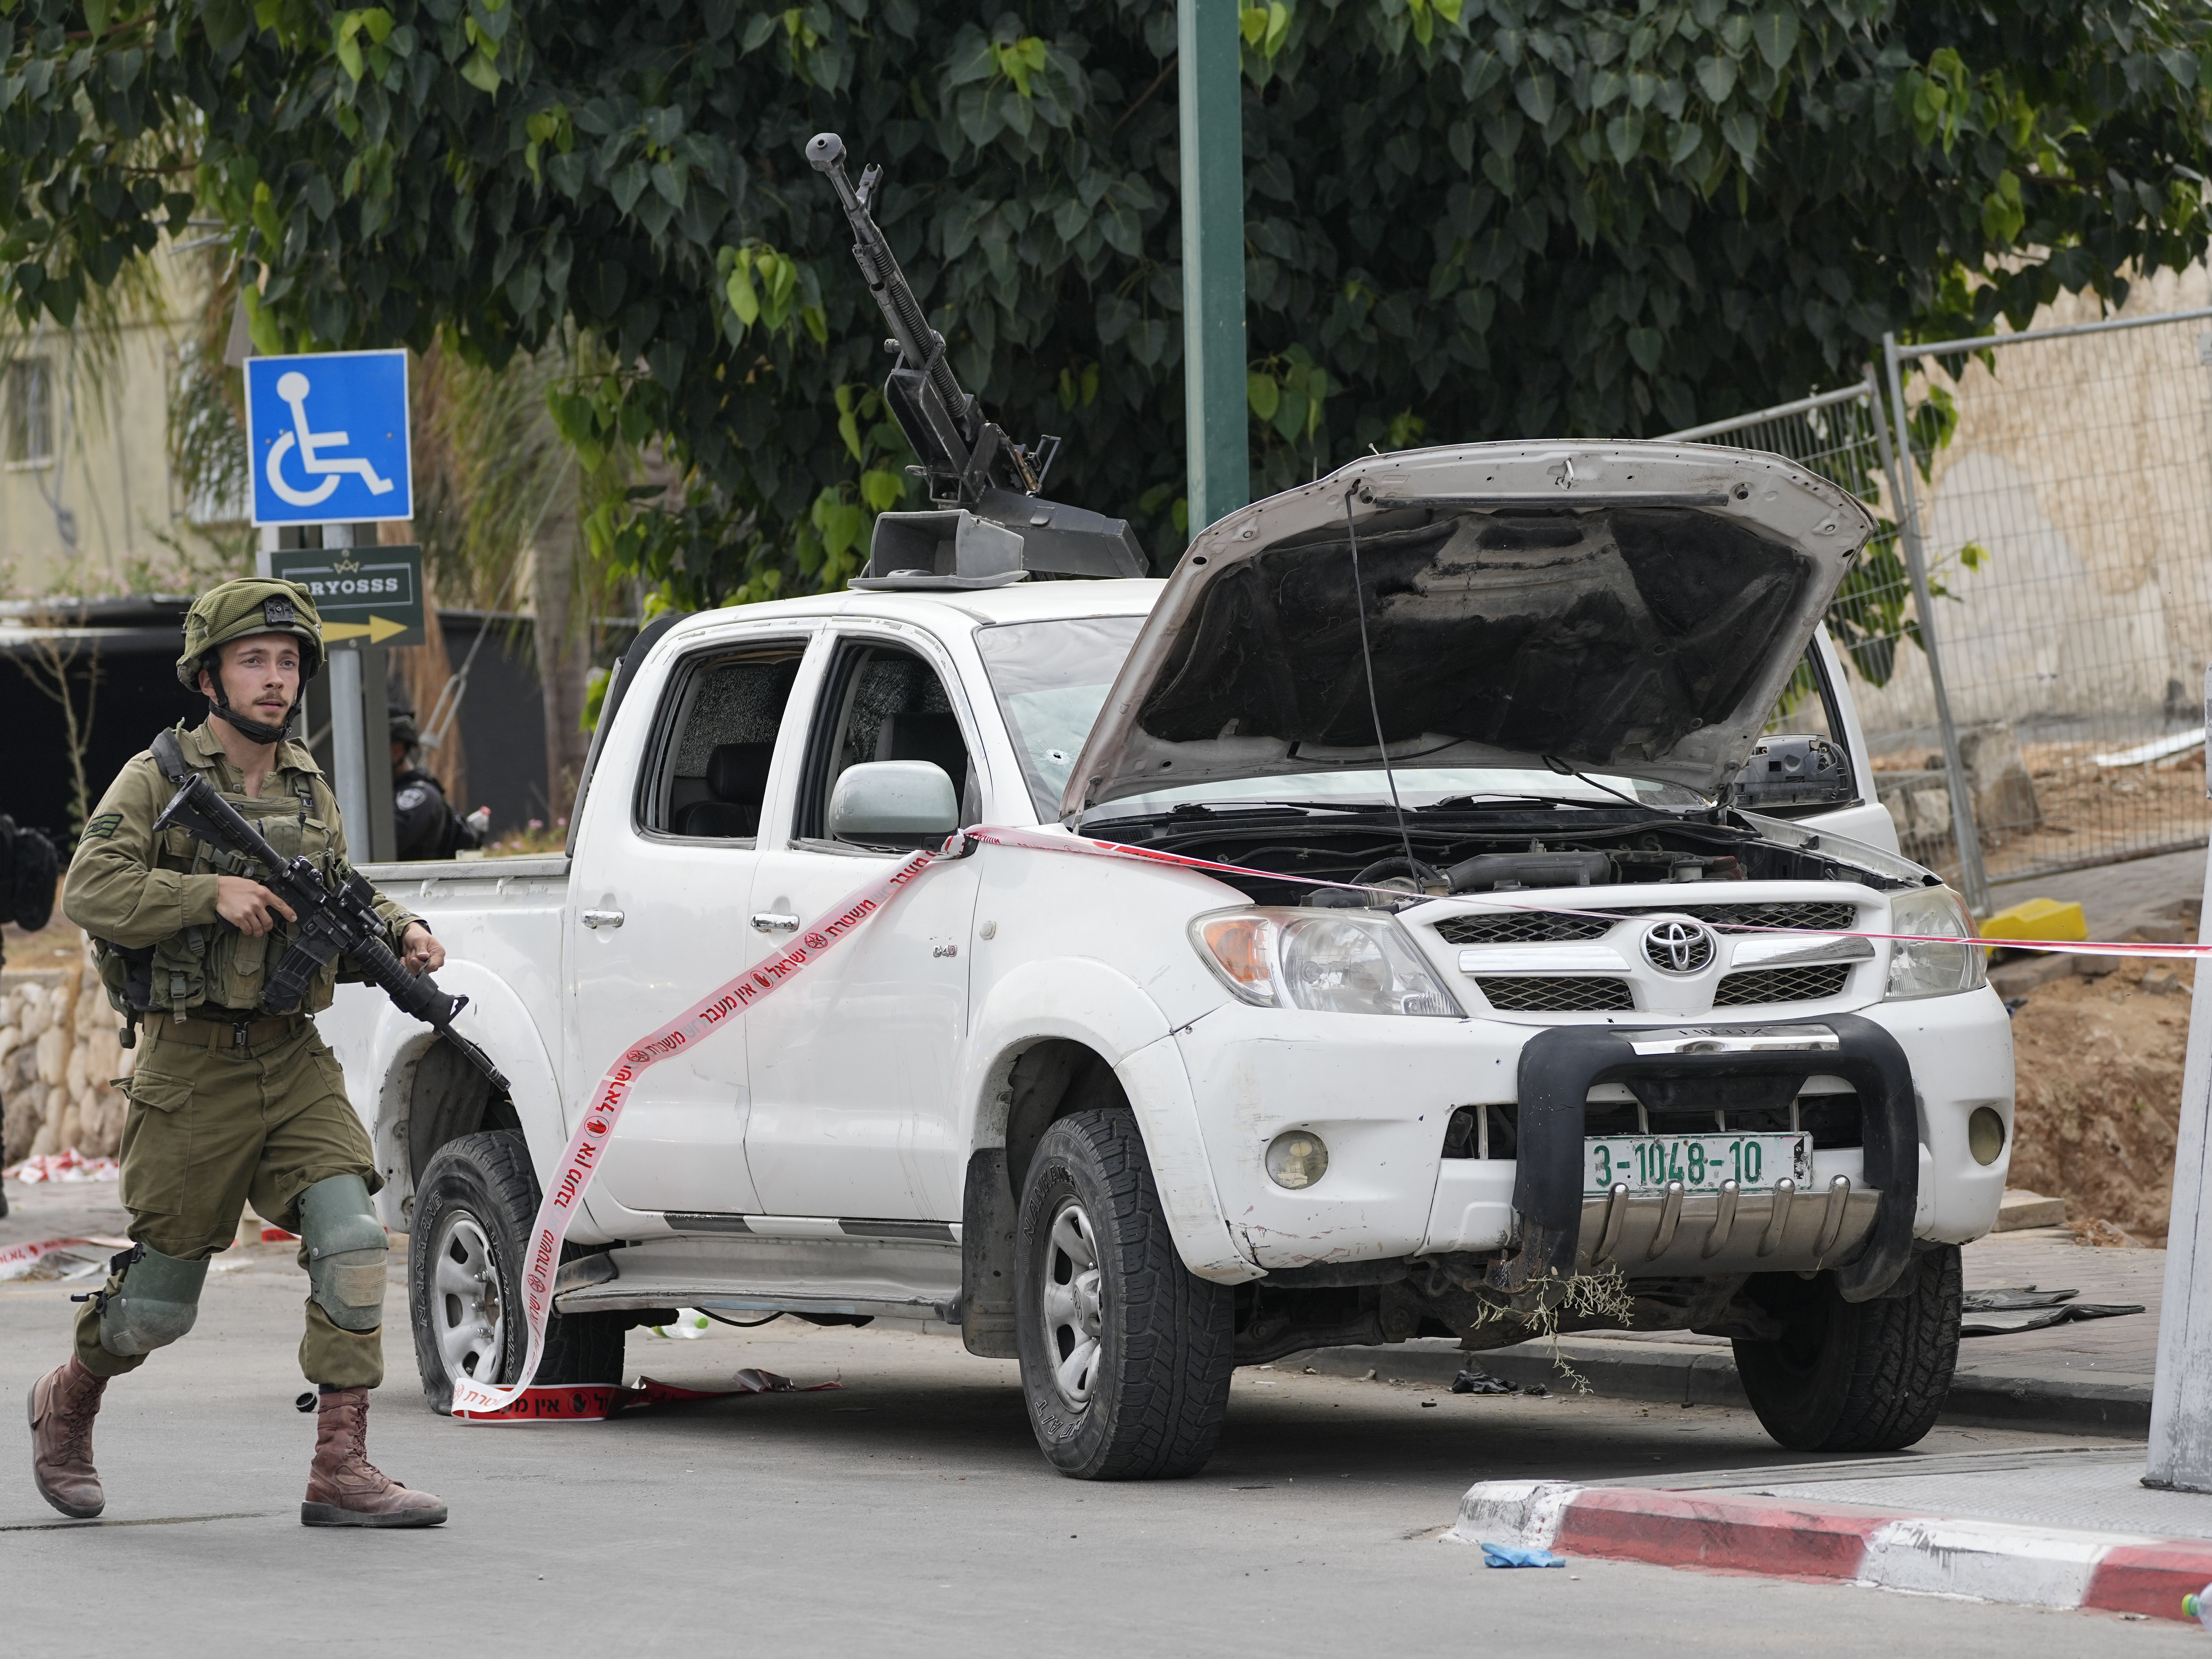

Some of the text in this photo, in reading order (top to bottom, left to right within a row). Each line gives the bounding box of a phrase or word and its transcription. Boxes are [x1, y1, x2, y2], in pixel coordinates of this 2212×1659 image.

[299, 578, 398, 596] RYOSSS
[824, 899, 877, 937] משטרת
[766, 947, 807, 979] ישראל
[699, 996, 738, 1024] מעבר
[734, 983, 758, 1006] אין
[644, 1031, 686, 1055] משטרת
[595, 1065, 632, 1113] ישראל
[574, 1142, 597, 1169] אין
[1594, 1140, 1762, 1187] 3-1048-10
[554, 1169, 582, 1208] מעבר
[416, 1190, 443, 1327] NANKANG
[534, 1229, 554, 1278] משטרת
[534, 1398, 560, 1416] אין
